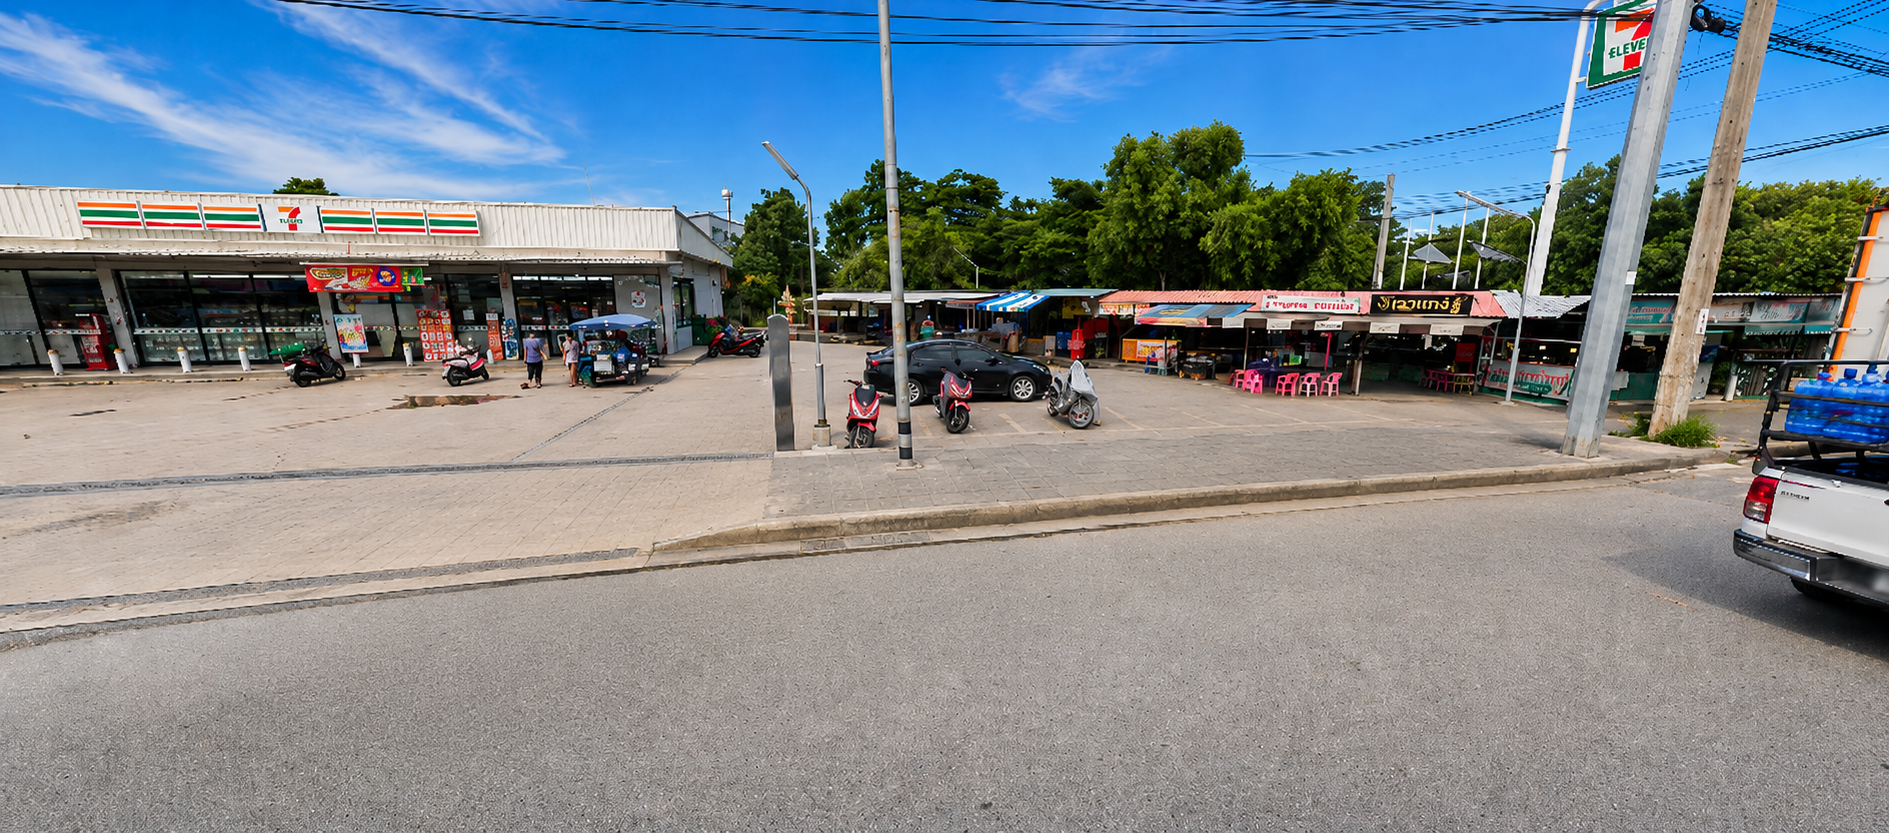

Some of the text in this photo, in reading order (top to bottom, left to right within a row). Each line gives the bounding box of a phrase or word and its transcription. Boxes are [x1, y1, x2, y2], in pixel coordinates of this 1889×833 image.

[1608, 37, 1648, 59] ELEVE
[1615, 7, 1655, 70] 7
[278, 206, 301, 231] 7
